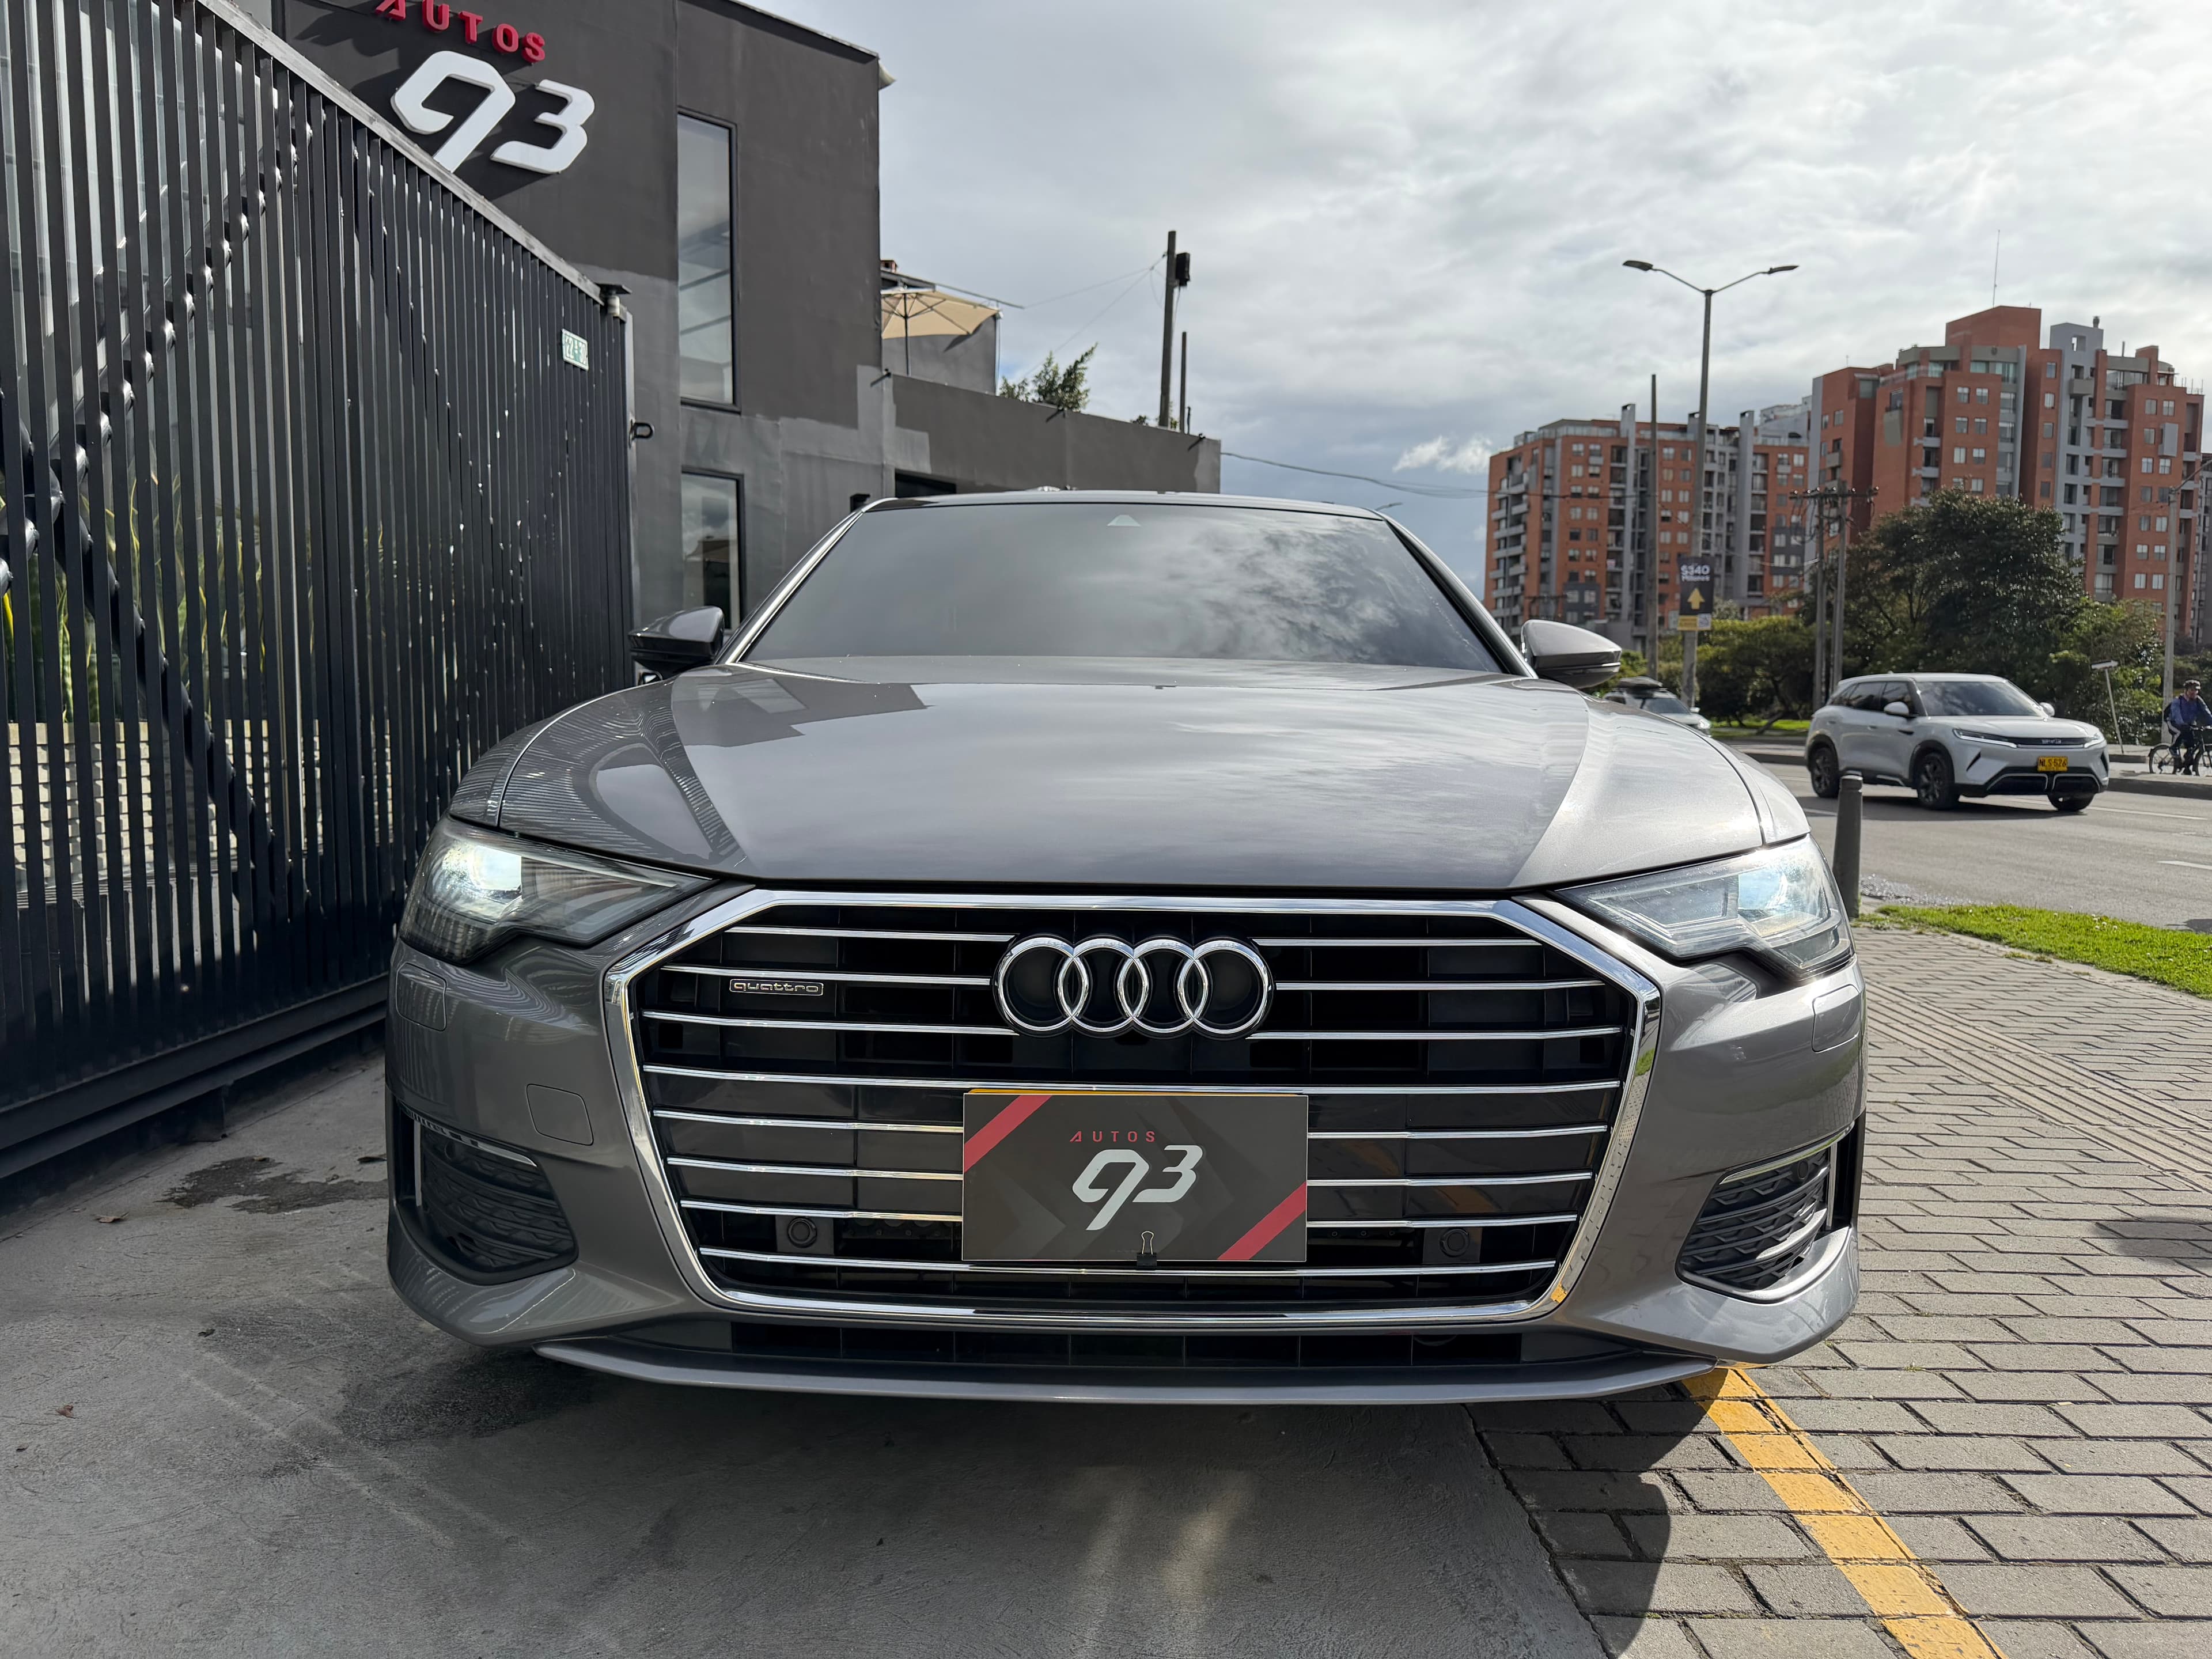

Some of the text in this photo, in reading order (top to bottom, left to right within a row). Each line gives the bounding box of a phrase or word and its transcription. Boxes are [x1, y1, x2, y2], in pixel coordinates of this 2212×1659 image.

[391, 50, 595, 173] 93
[734, 982, 819, 993] quattro
[1070, 1131, 1155, 1142] AUTOS
[1072, 1145, 1203, 1230] 93
